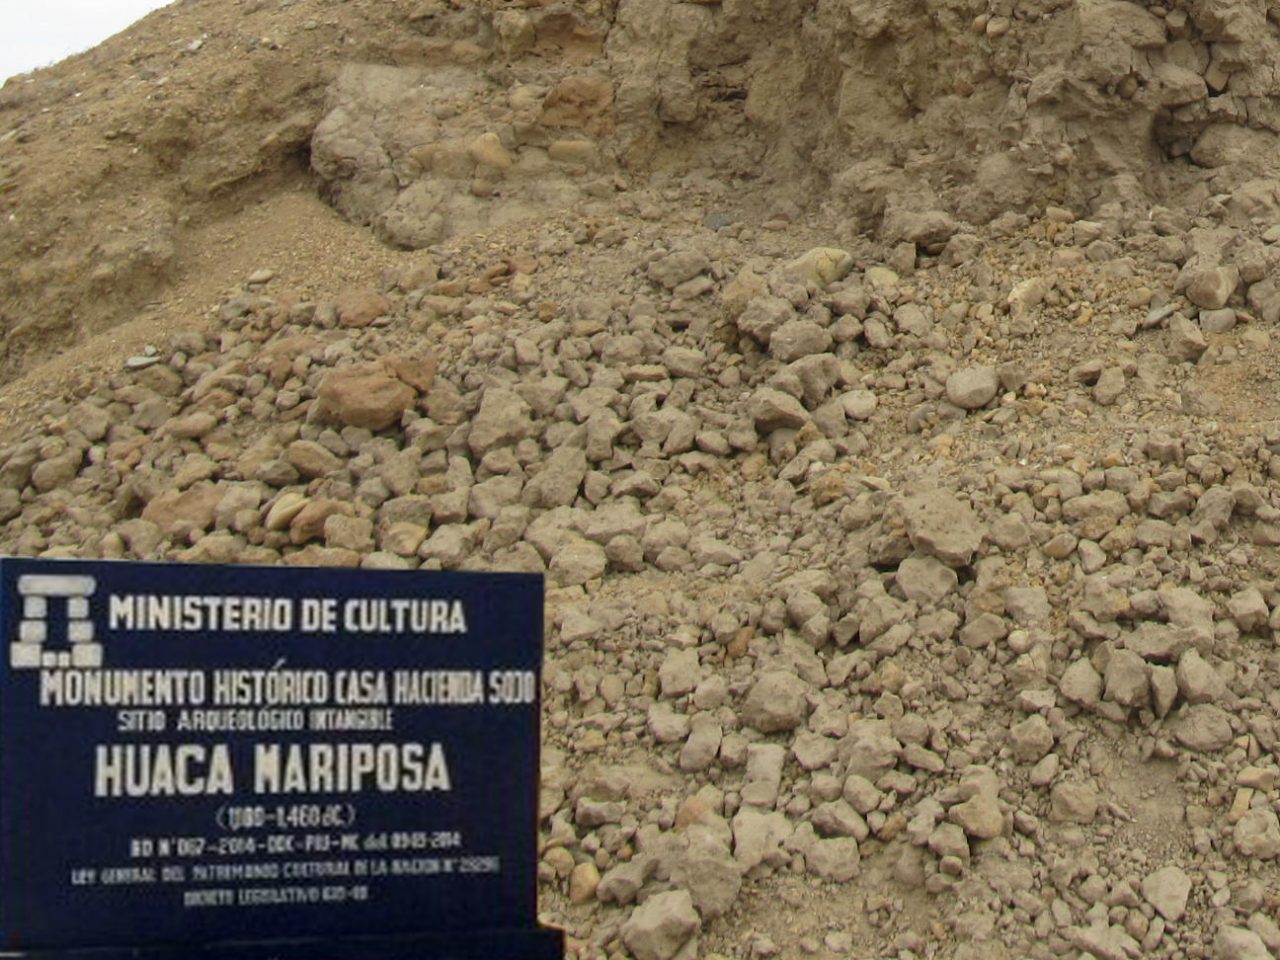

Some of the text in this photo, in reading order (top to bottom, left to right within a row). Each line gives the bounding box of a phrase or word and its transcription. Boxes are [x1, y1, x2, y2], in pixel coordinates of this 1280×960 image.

[110, 594, 467, 634] MINISTERIO DE CULTURA
[40, 670, 205, 706] MONUMENTO
[213, 658, 328, 705] HISTÓRICO
[335, 670, 388, 704] CASA
[394, 670, 484, 704] HACIENDA
[117, 709, 166, 732] SITIO
[94, 742, 451, 797] HUACA MARIPOSA
